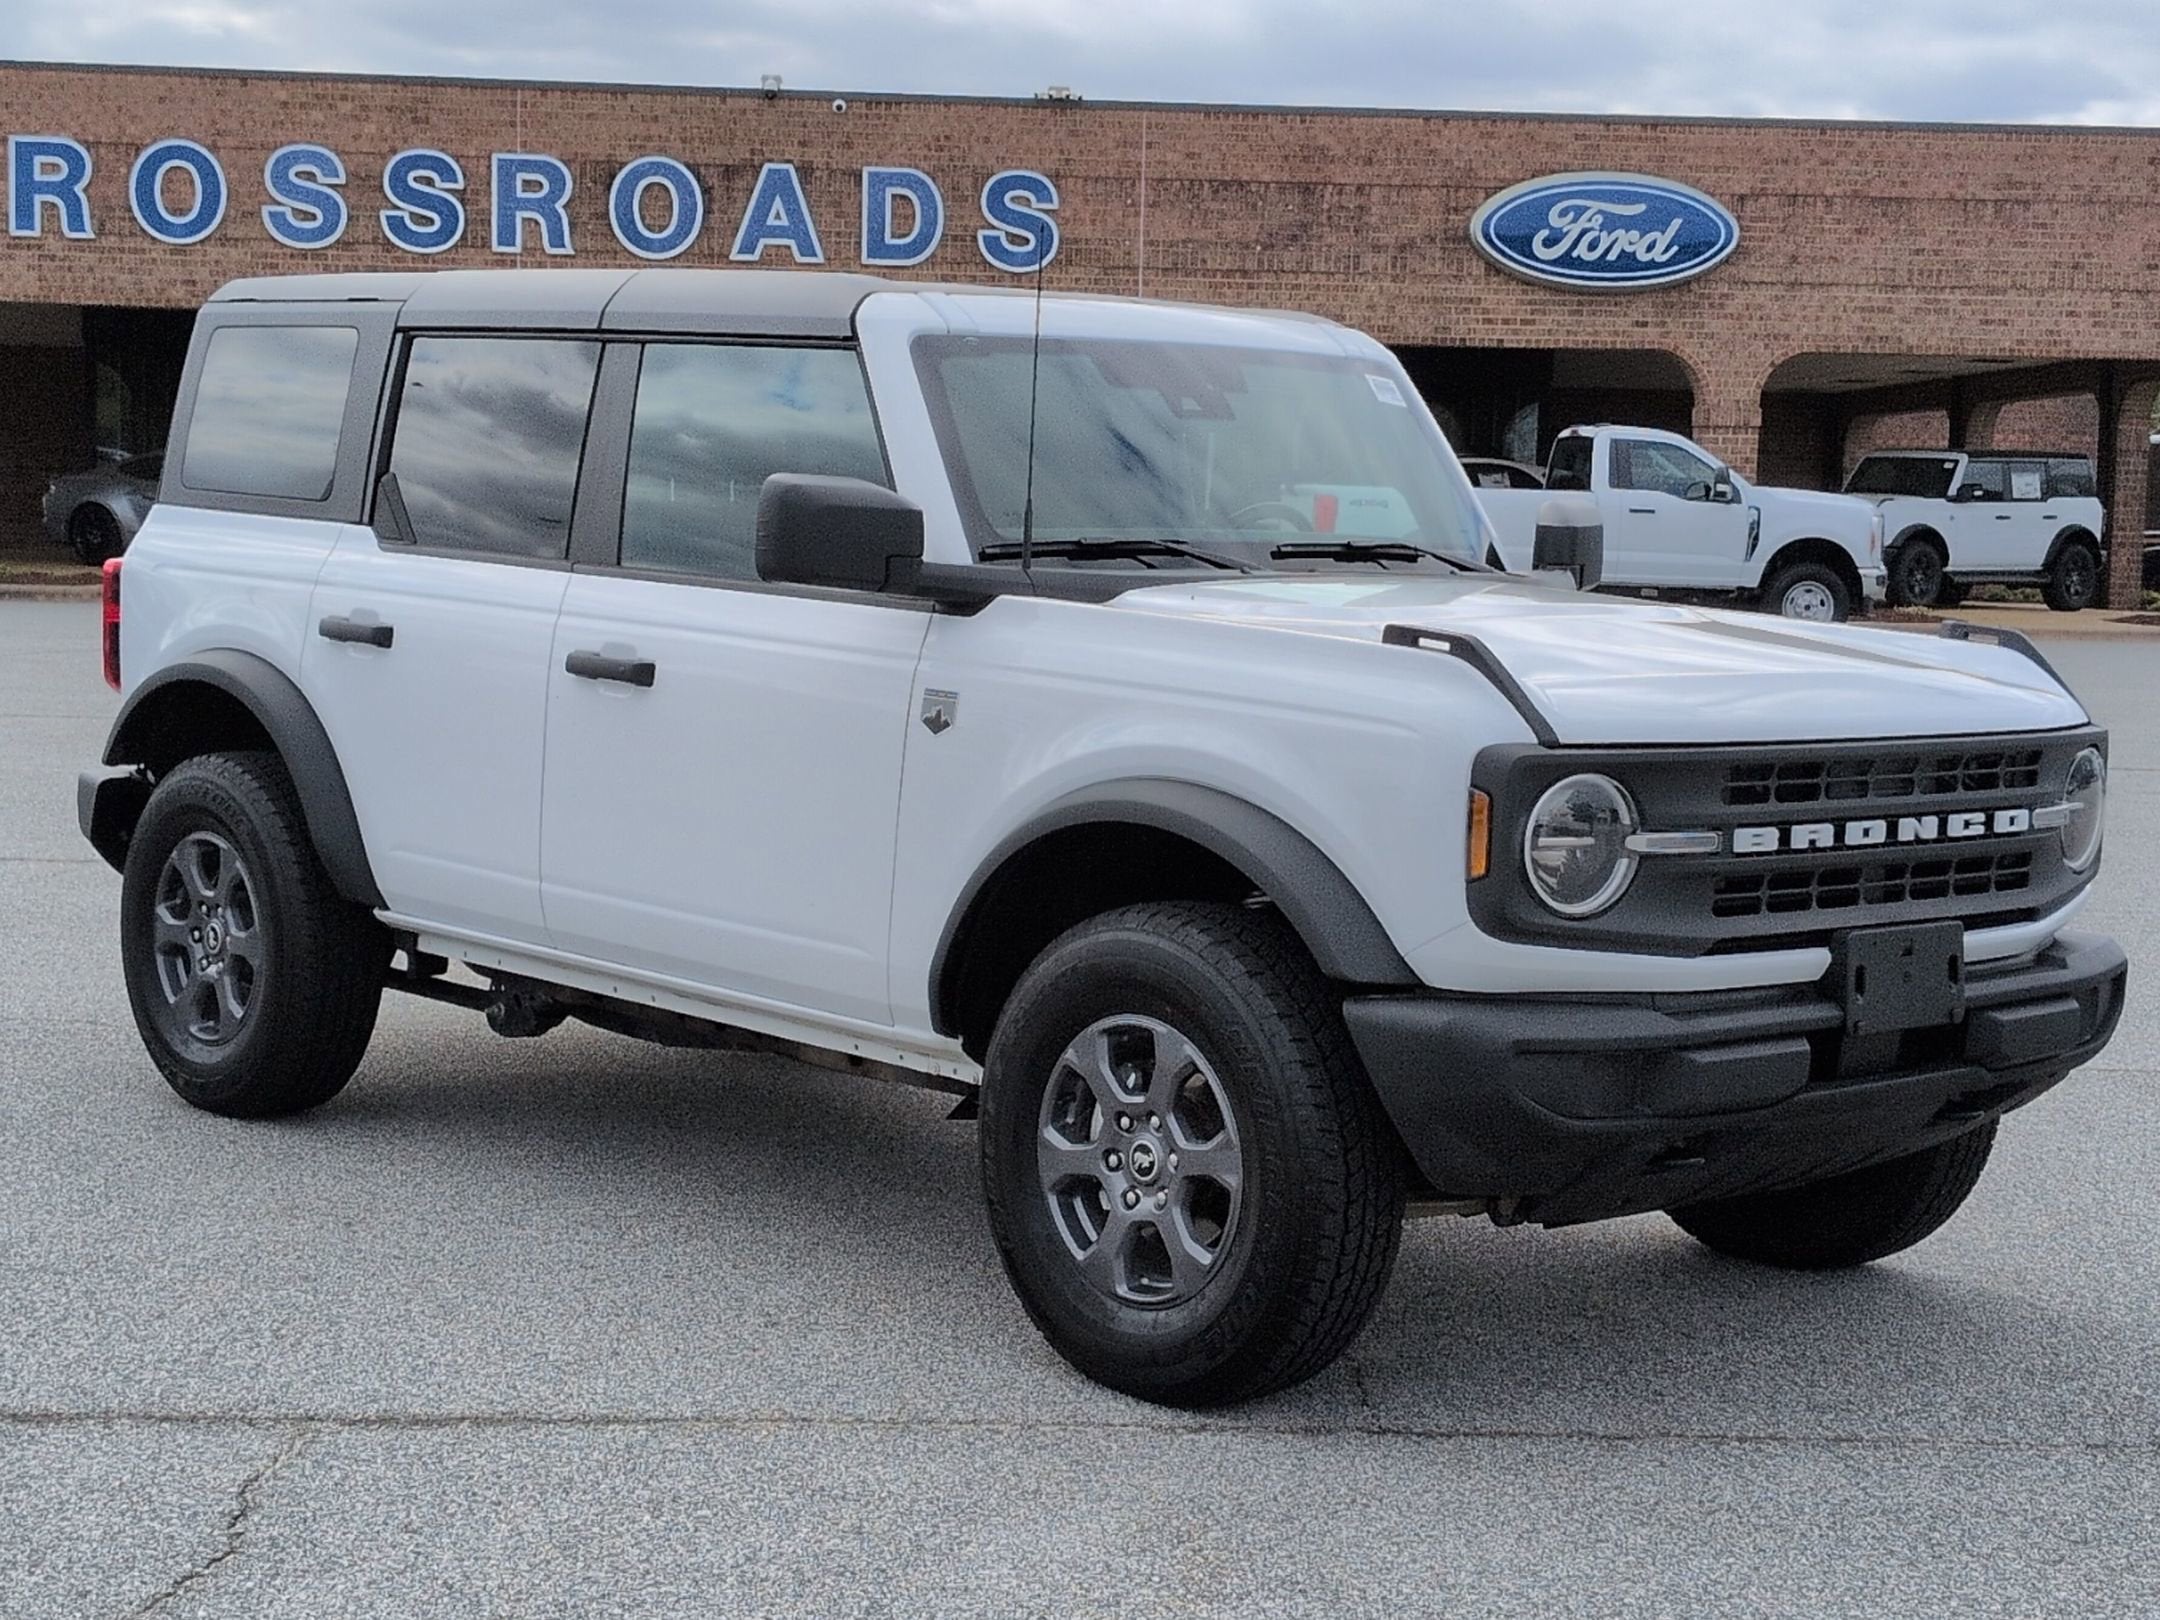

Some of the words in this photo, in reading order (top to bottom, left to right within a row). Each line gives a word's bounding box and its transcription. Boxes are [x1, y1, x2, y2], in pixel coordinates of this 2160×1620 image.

[8, 133, 1061, 274] ROSSROADS
[1532, 199, 1683, 263] Ford
[1733, 809, 2030, 853] BRONCO
